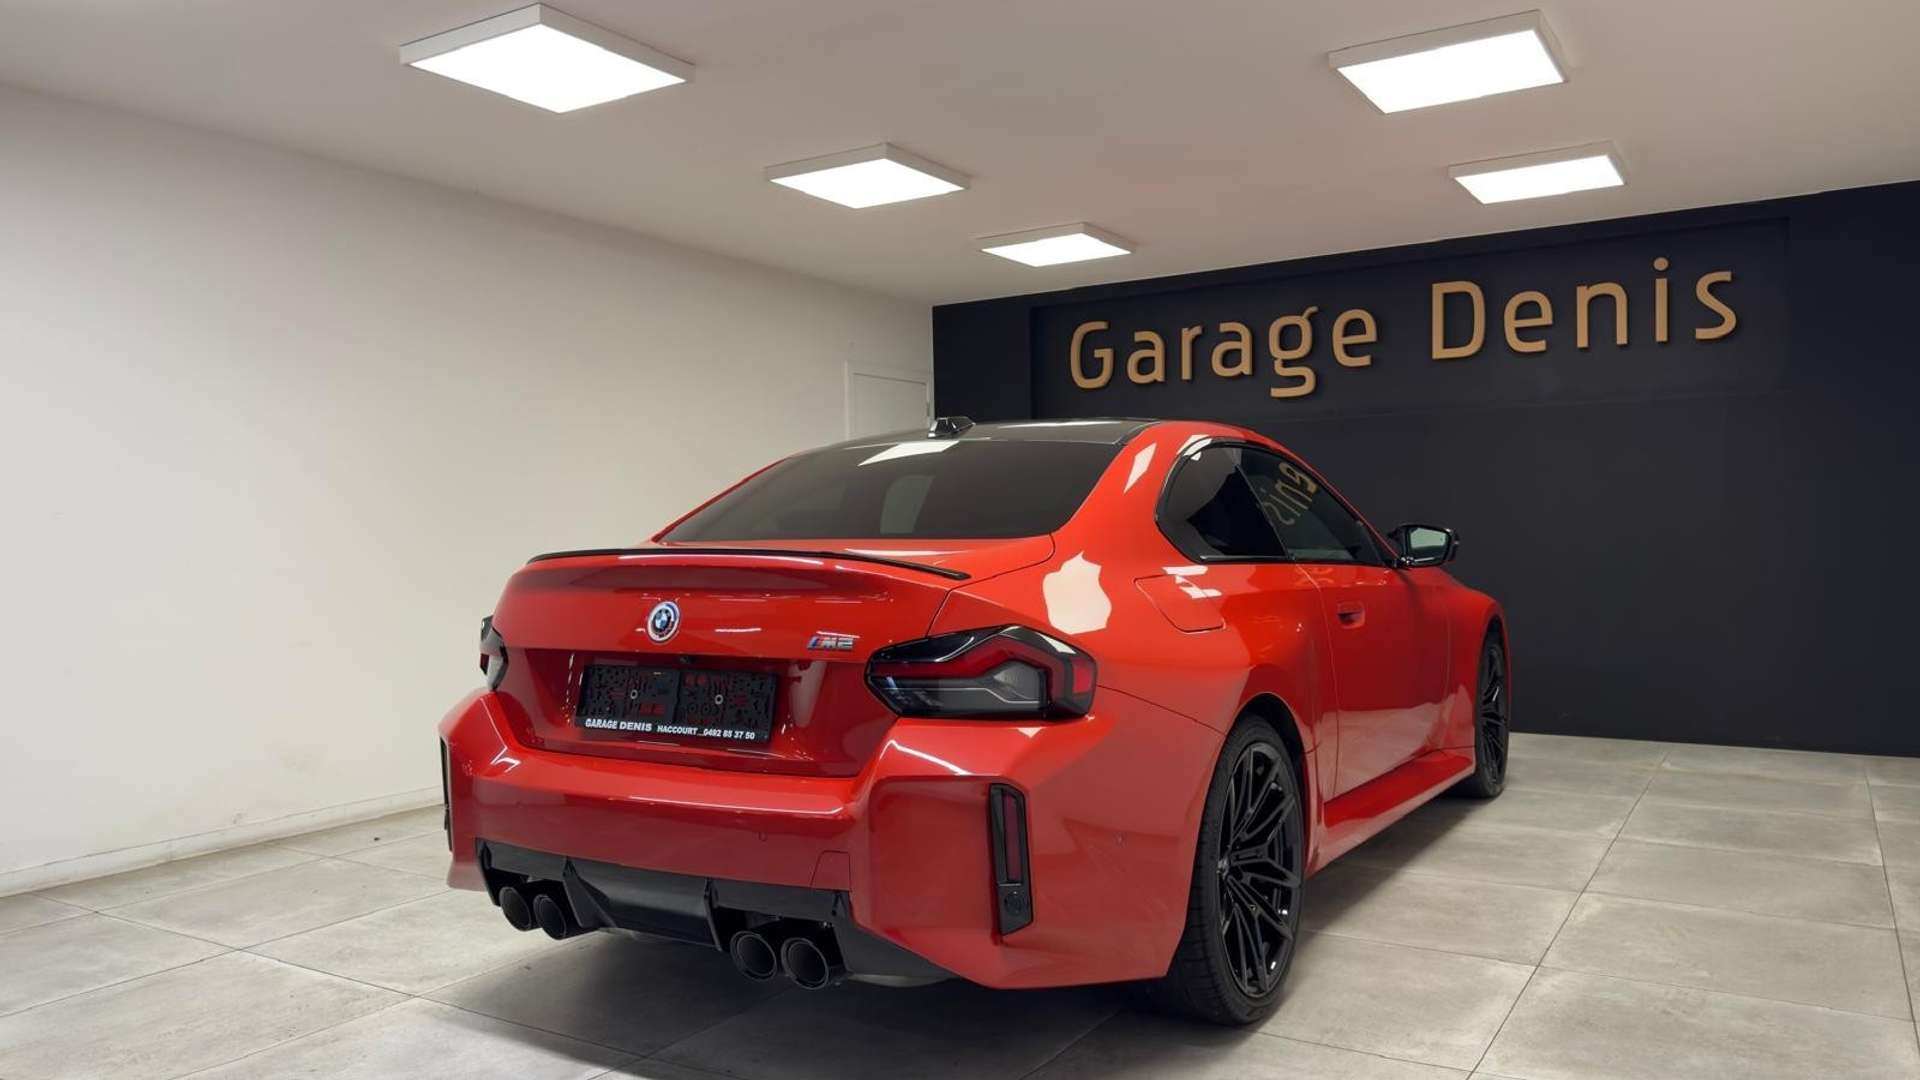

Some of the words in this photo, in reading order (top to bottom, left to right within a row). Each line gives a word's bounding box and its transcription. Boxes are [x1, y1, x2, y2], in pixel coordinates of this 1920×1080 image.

[1071, 306, 1377, 398] Garage
[1431, 257, 1737, 360] Denis
[585, 718, 617, 730] GARAGE
[619, 721, 652, 732] DENIS
[656, 725, 698, 736] HACCOURT
